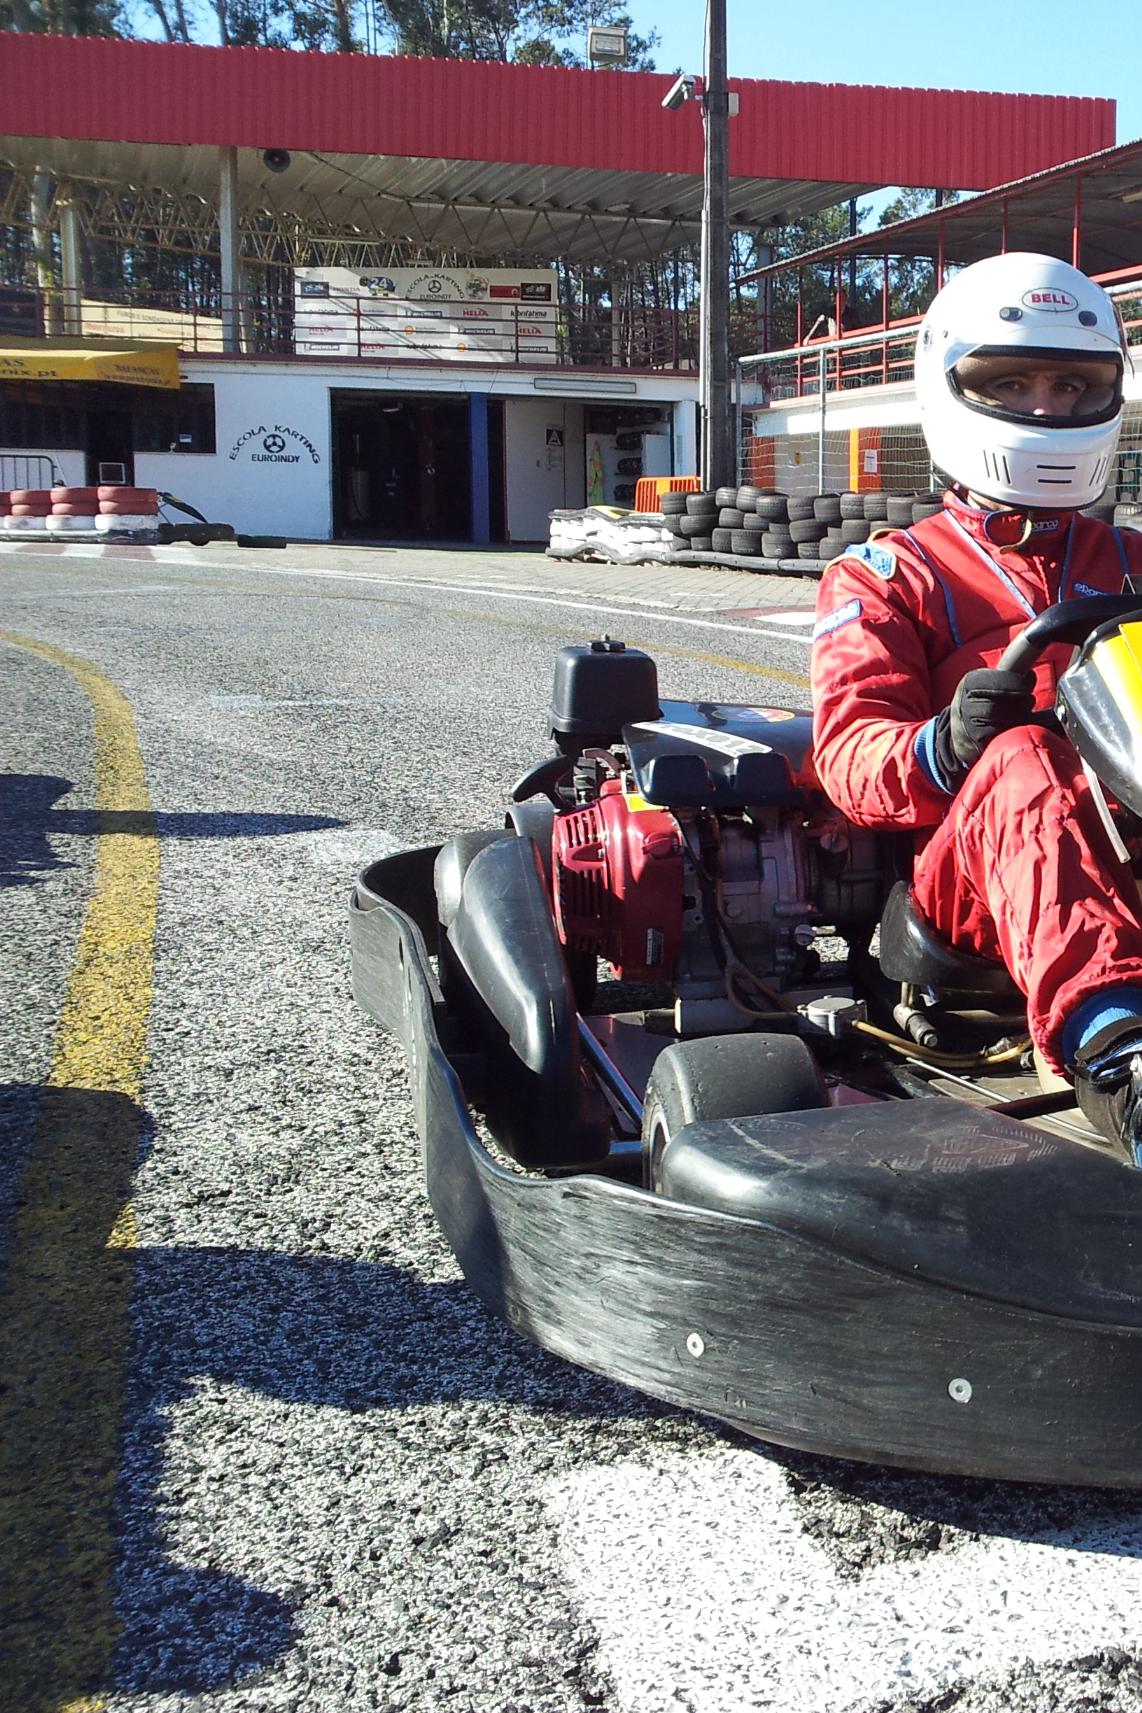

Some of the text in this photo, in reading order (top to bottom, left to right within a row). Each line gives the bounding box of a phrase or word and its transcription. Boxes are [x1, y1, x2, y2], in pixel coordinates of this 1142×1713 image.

[1031, 293, 1070, 305] BELL
[229, 424, 321, 464] ESCOLA KARTING
[251, 453, 301, 463] EUROINDY
